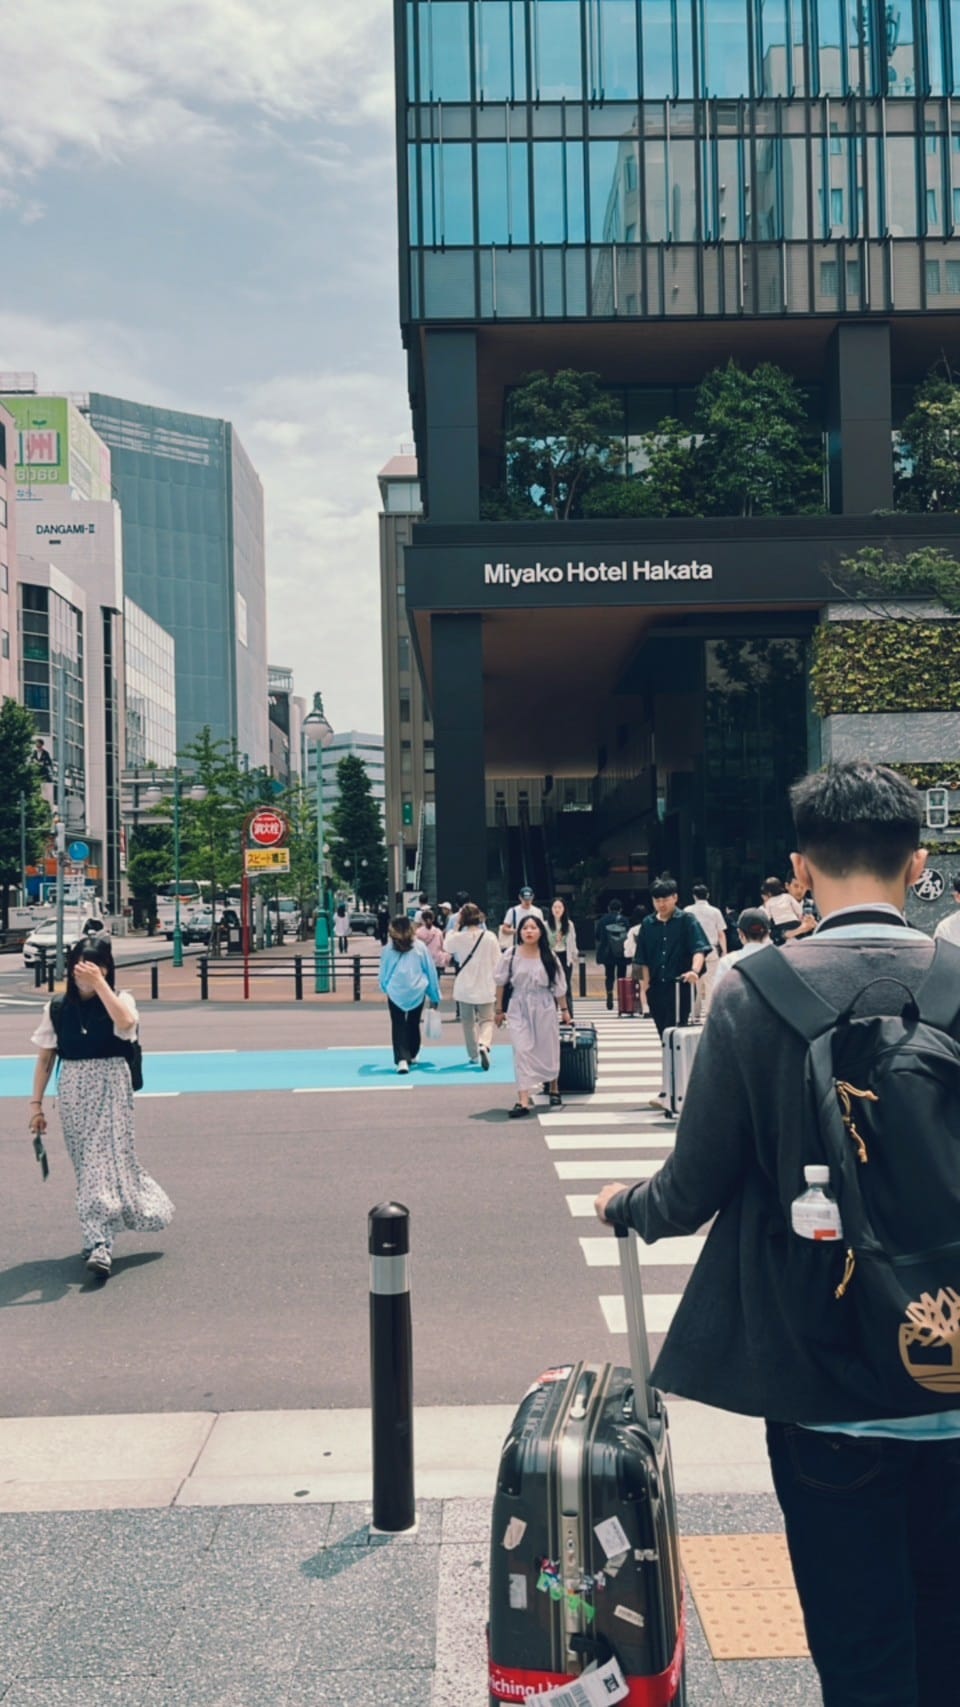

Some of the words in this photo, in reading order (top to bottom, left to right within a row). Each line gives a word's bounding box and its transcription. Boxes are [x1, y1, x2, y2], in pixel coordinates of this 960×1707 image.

[484, 562, 564, 587] Miyako
[567, 560, 628, 582] Hotel
[633, 559, 714, 581] Hakata
